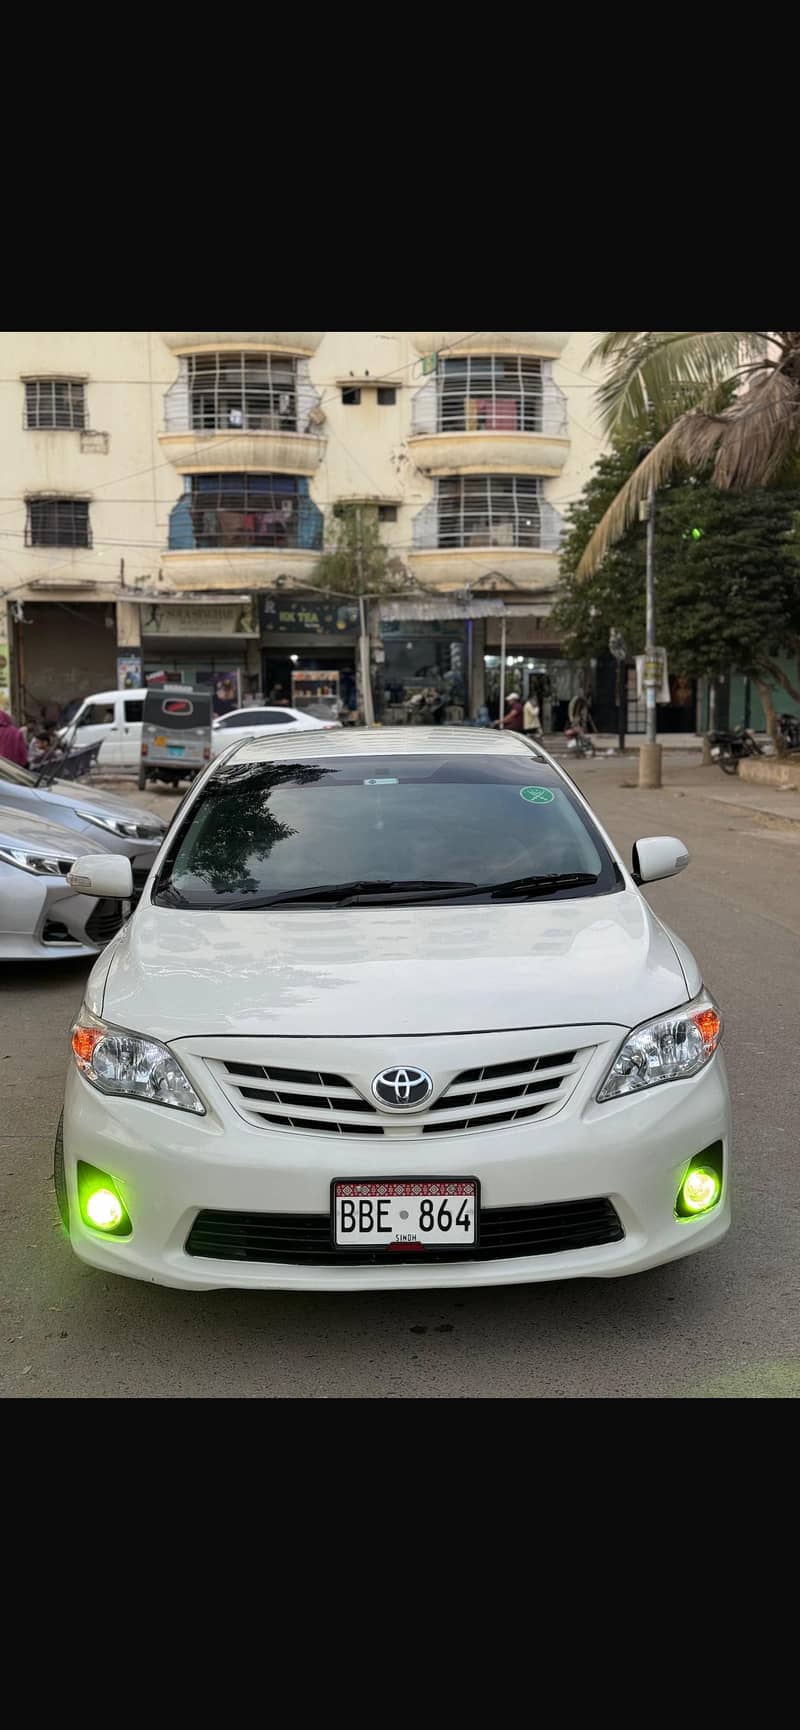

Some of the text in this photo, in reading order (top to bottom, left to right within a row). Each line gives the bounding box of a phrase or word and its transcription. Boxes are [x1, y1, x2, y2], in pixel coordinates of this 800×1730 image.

[297, 611, 319, 623] TEA
[341, 1198, 471, 1233] BBE 864
[395, 1233, 417, 1242] SINDH
